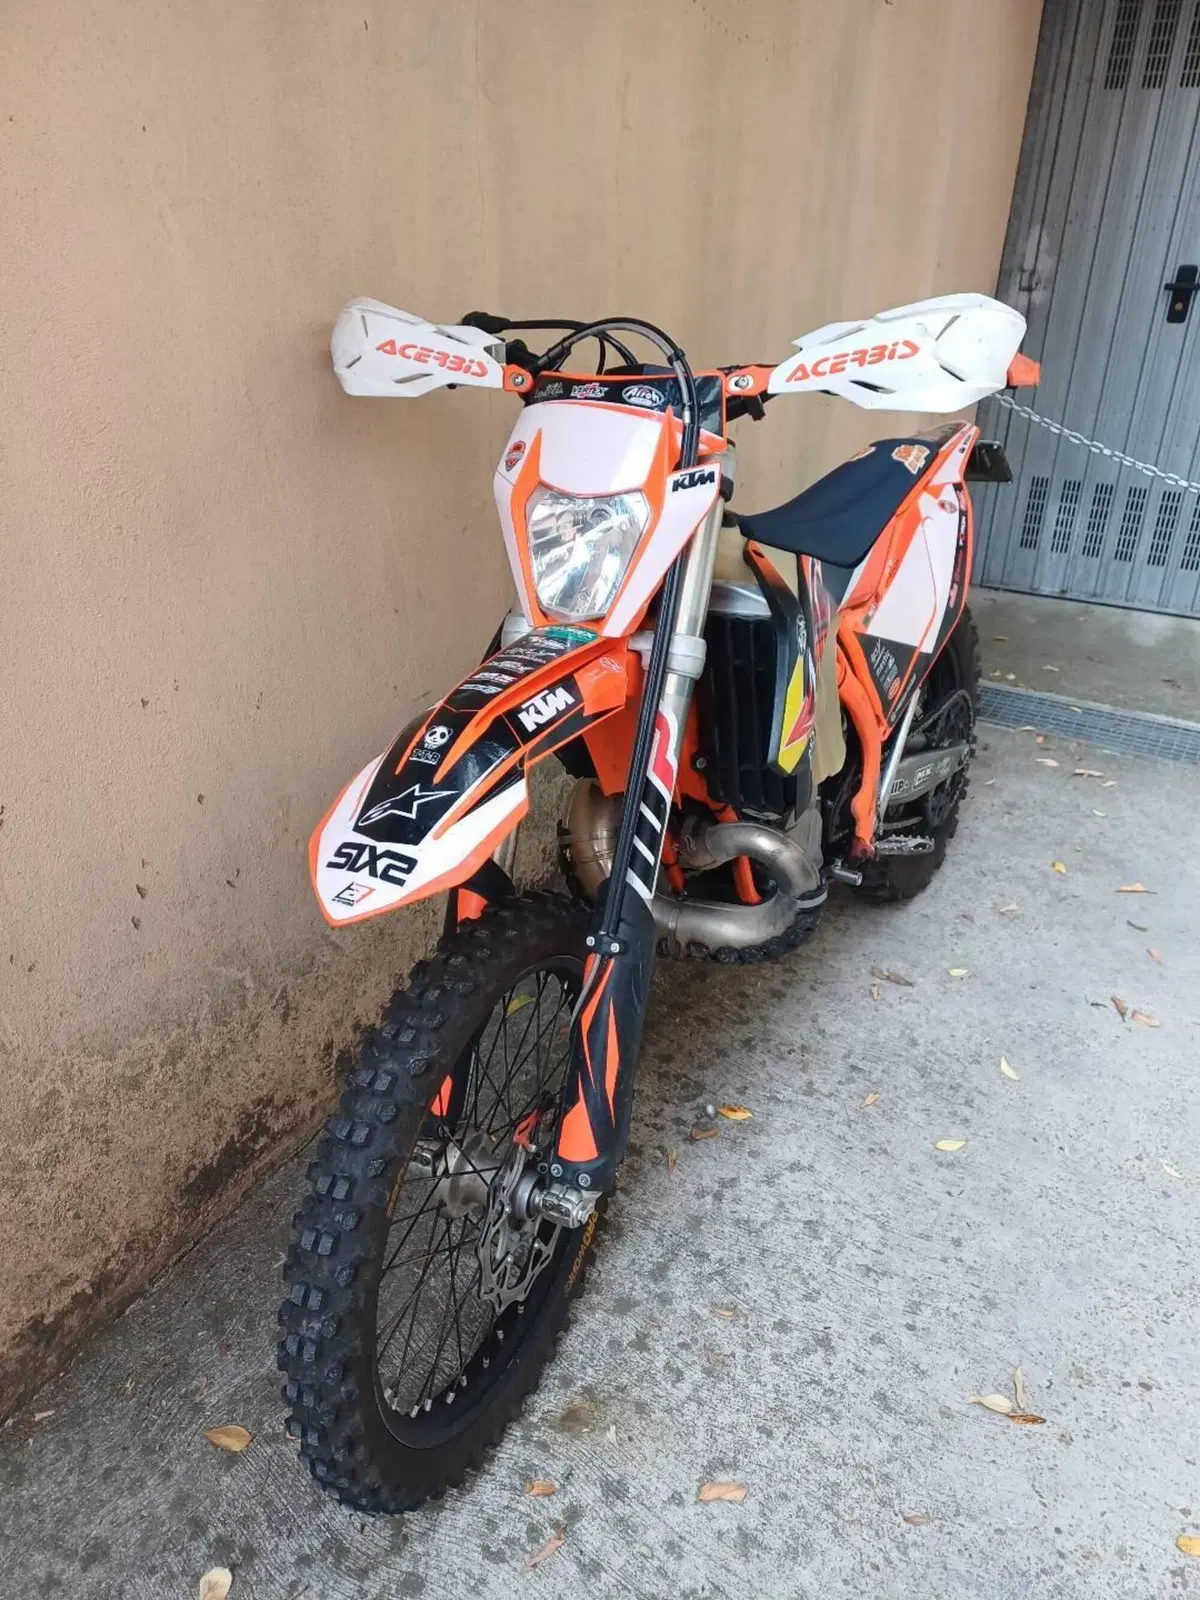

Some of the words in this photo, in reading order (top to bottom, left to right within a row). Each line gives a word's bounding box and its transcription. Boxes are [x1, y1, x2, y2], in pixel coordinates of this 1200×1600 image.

[625, 385, 660, 403] Airoh
[672, 469, 716, 492] KTM
[517, 686, 576, 732] KTM
[325, 841, 419, 888] SIX2
